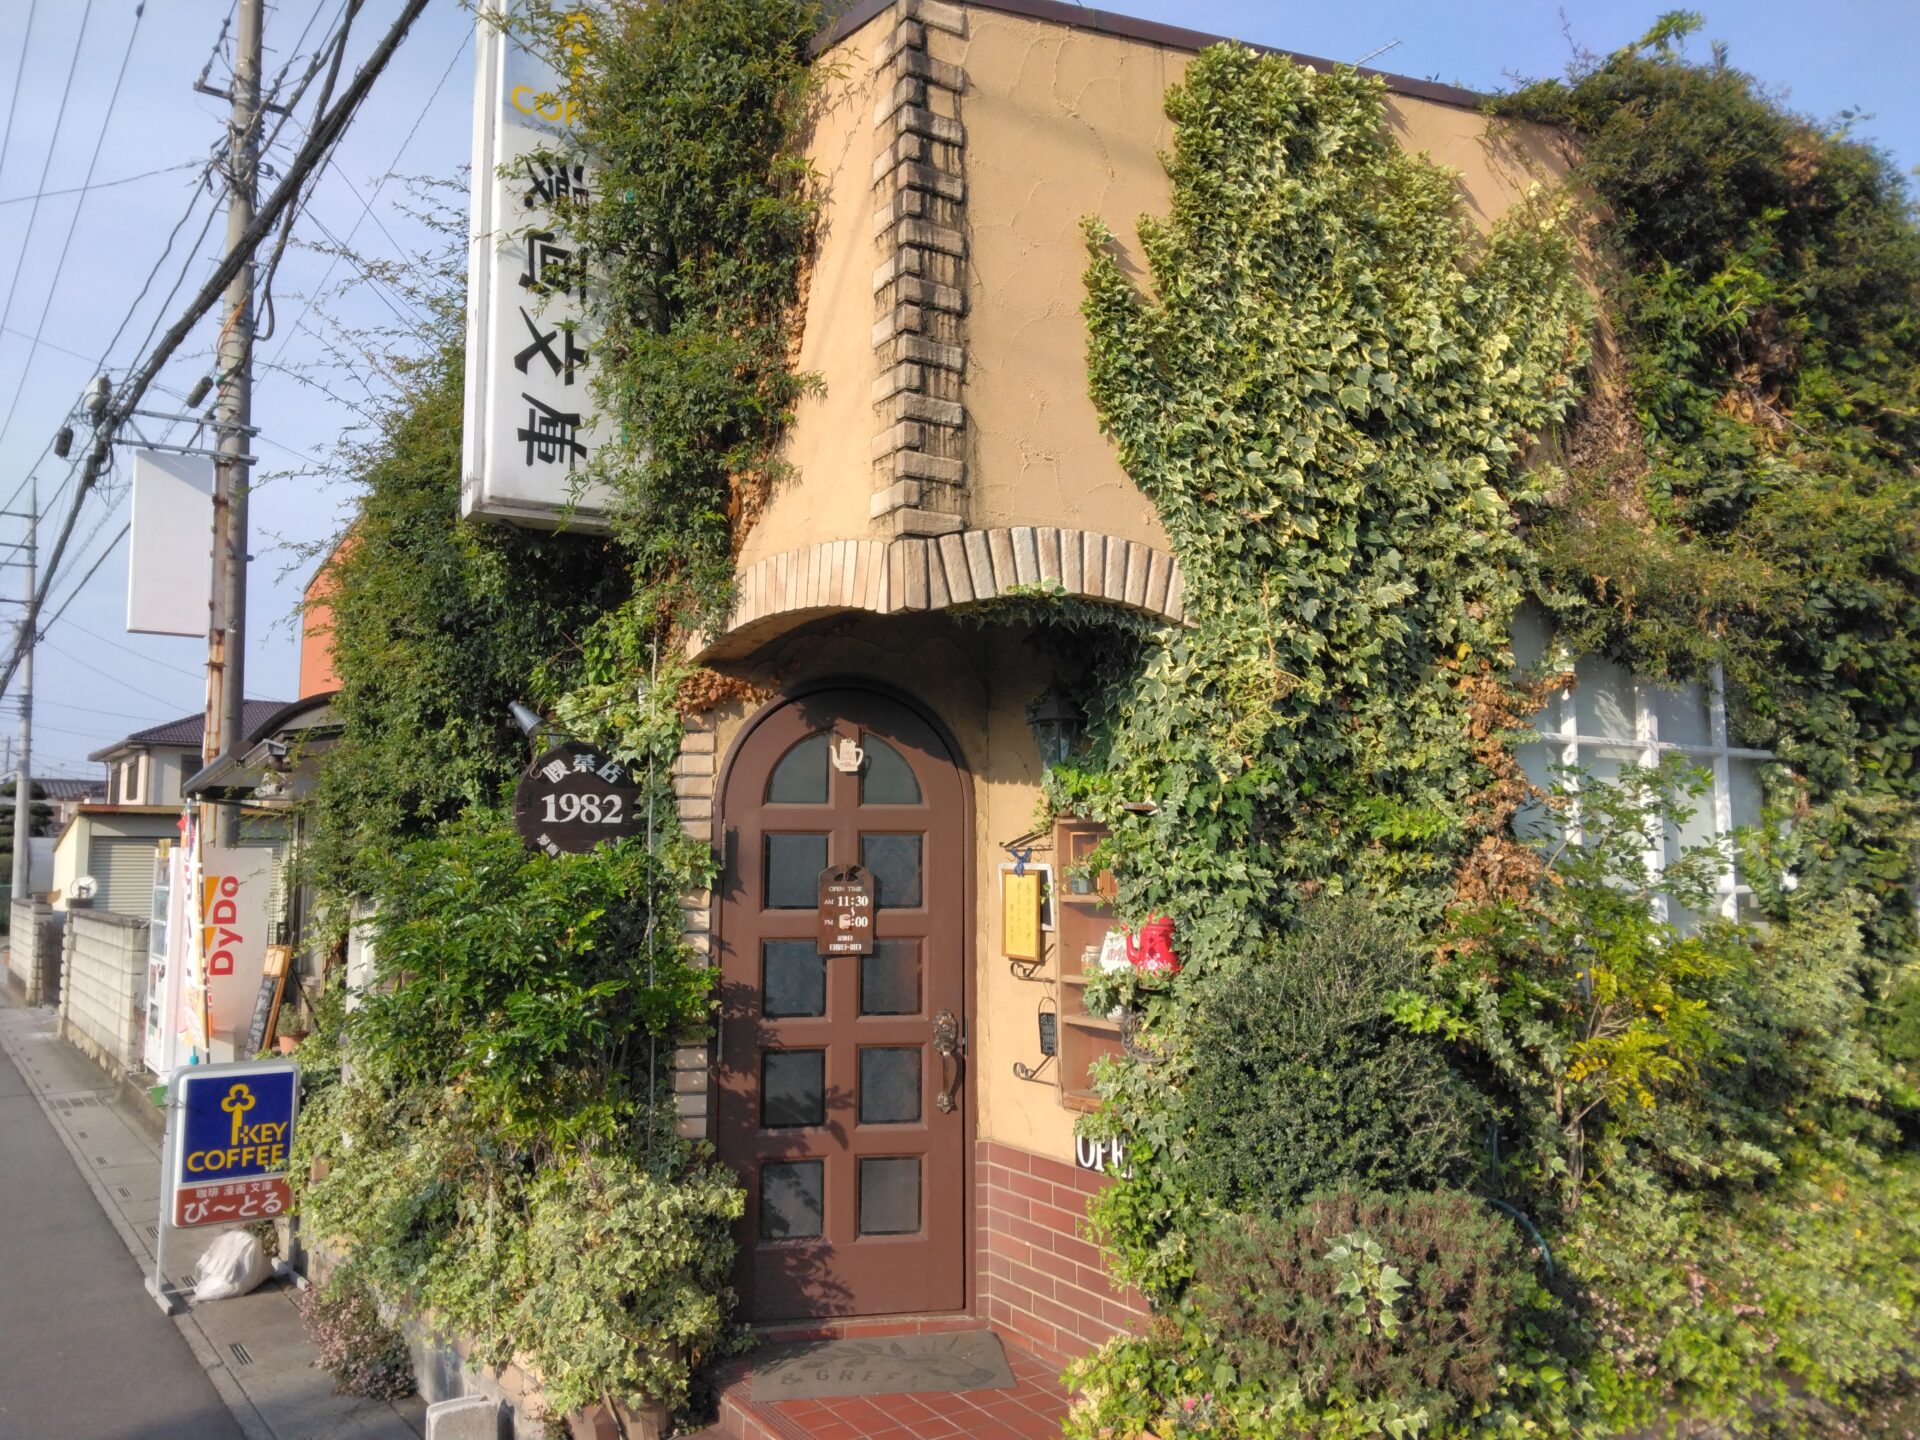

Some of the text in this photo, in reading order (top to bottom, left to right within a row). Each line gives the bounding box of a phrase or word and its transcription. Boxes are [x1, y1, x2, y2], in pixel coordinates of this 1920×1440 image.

[541, 753, 624, 784] 喫茶店
[541, 793, 623, 824] 1982
[837, 895, 869, 907] 11:30
[209, 875, 243, 976] DyDo
[239, 1121, 288, 1145] KEY
[186, 1143, 285, 1173] COFFEE
[249, 1180, 273, 1193] 文庫
